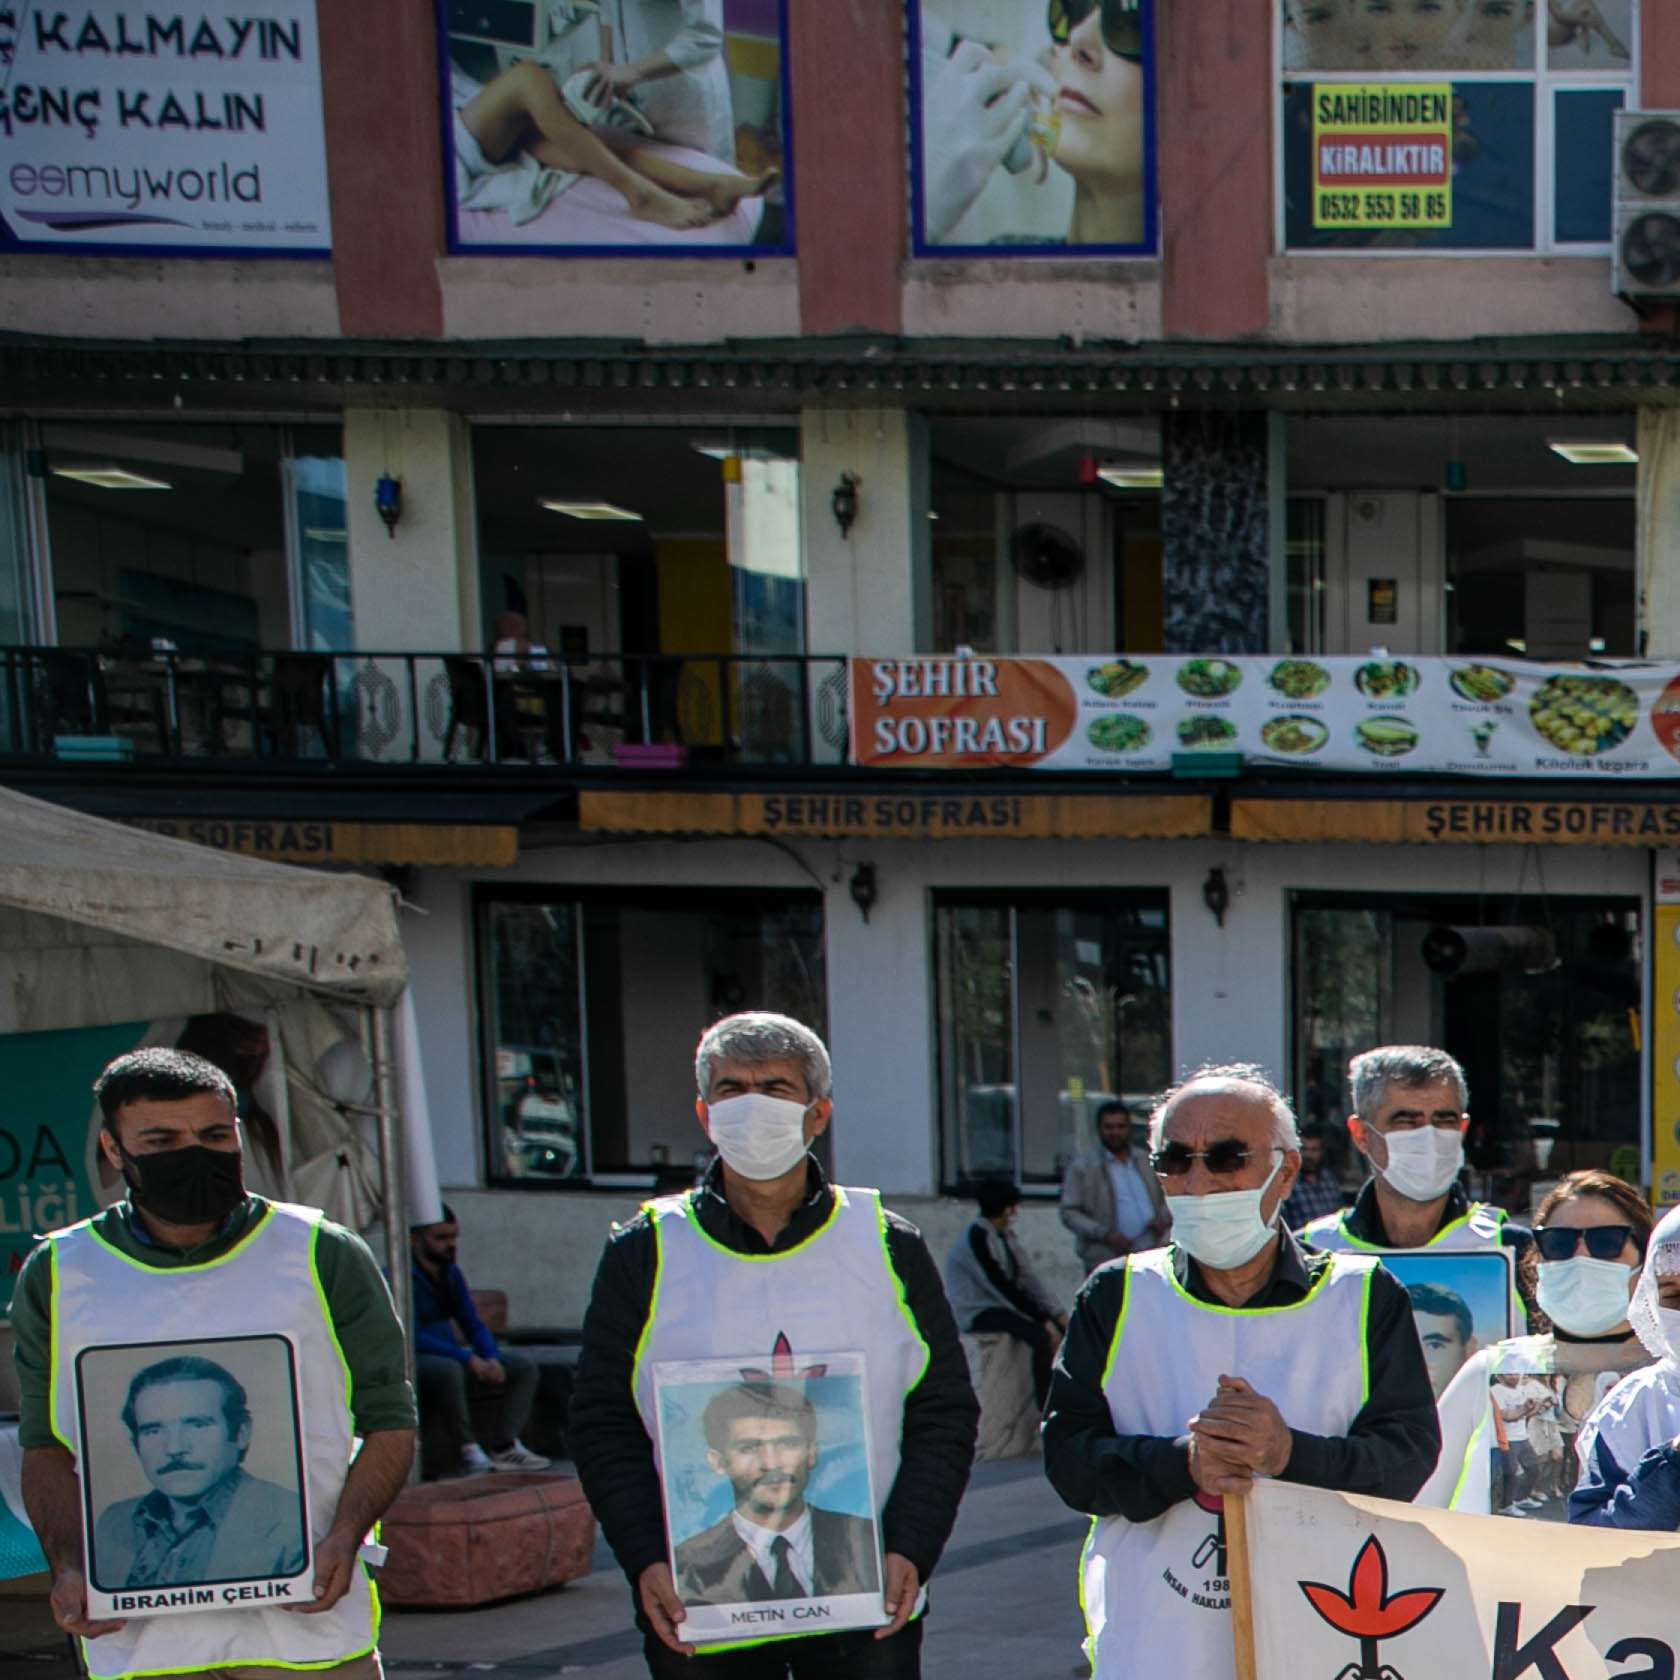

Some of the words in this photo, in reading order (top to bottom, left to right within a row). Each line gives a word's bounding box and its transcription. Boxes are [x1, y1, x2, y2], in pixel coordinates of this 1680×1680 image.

[33, 10, 301, 61] KALMAYIN
[117, 88, 265, 133] KALIN
[1318, 88, 1448, 126] SAHİBİNDEN
[10, 162, 261, 209] esmyworld
[1320, 193, 1359, 221] 0532
[1365, 193, 1395, 221] 553
[1400, 193, 1421, 220] 58
[873, 660, 999, 705] ŞEHİR
[875, 716, 1046, 754] SOFRASI
[763, 799, 865, 828] ŞEHİR
[874, 800, 1021, 827] SOFRASI
[1425, 805, 1532, 839] ŞEHİR
[188, 822, 334, 852] SOFRASI
[111, 1586, 215, 1611] İBRAHİM
[221, 1581, 294, 1606] ÇELİK
[1161, 1567, 1189, 1598] İNSAN
[1191, 1592, 1232, 1609] HAKLAR
[1202, 1579, 1231, 1592] 198
[731, 1605, 785, 1625] METİN
[792, 1604, 831, 1619] CAN
